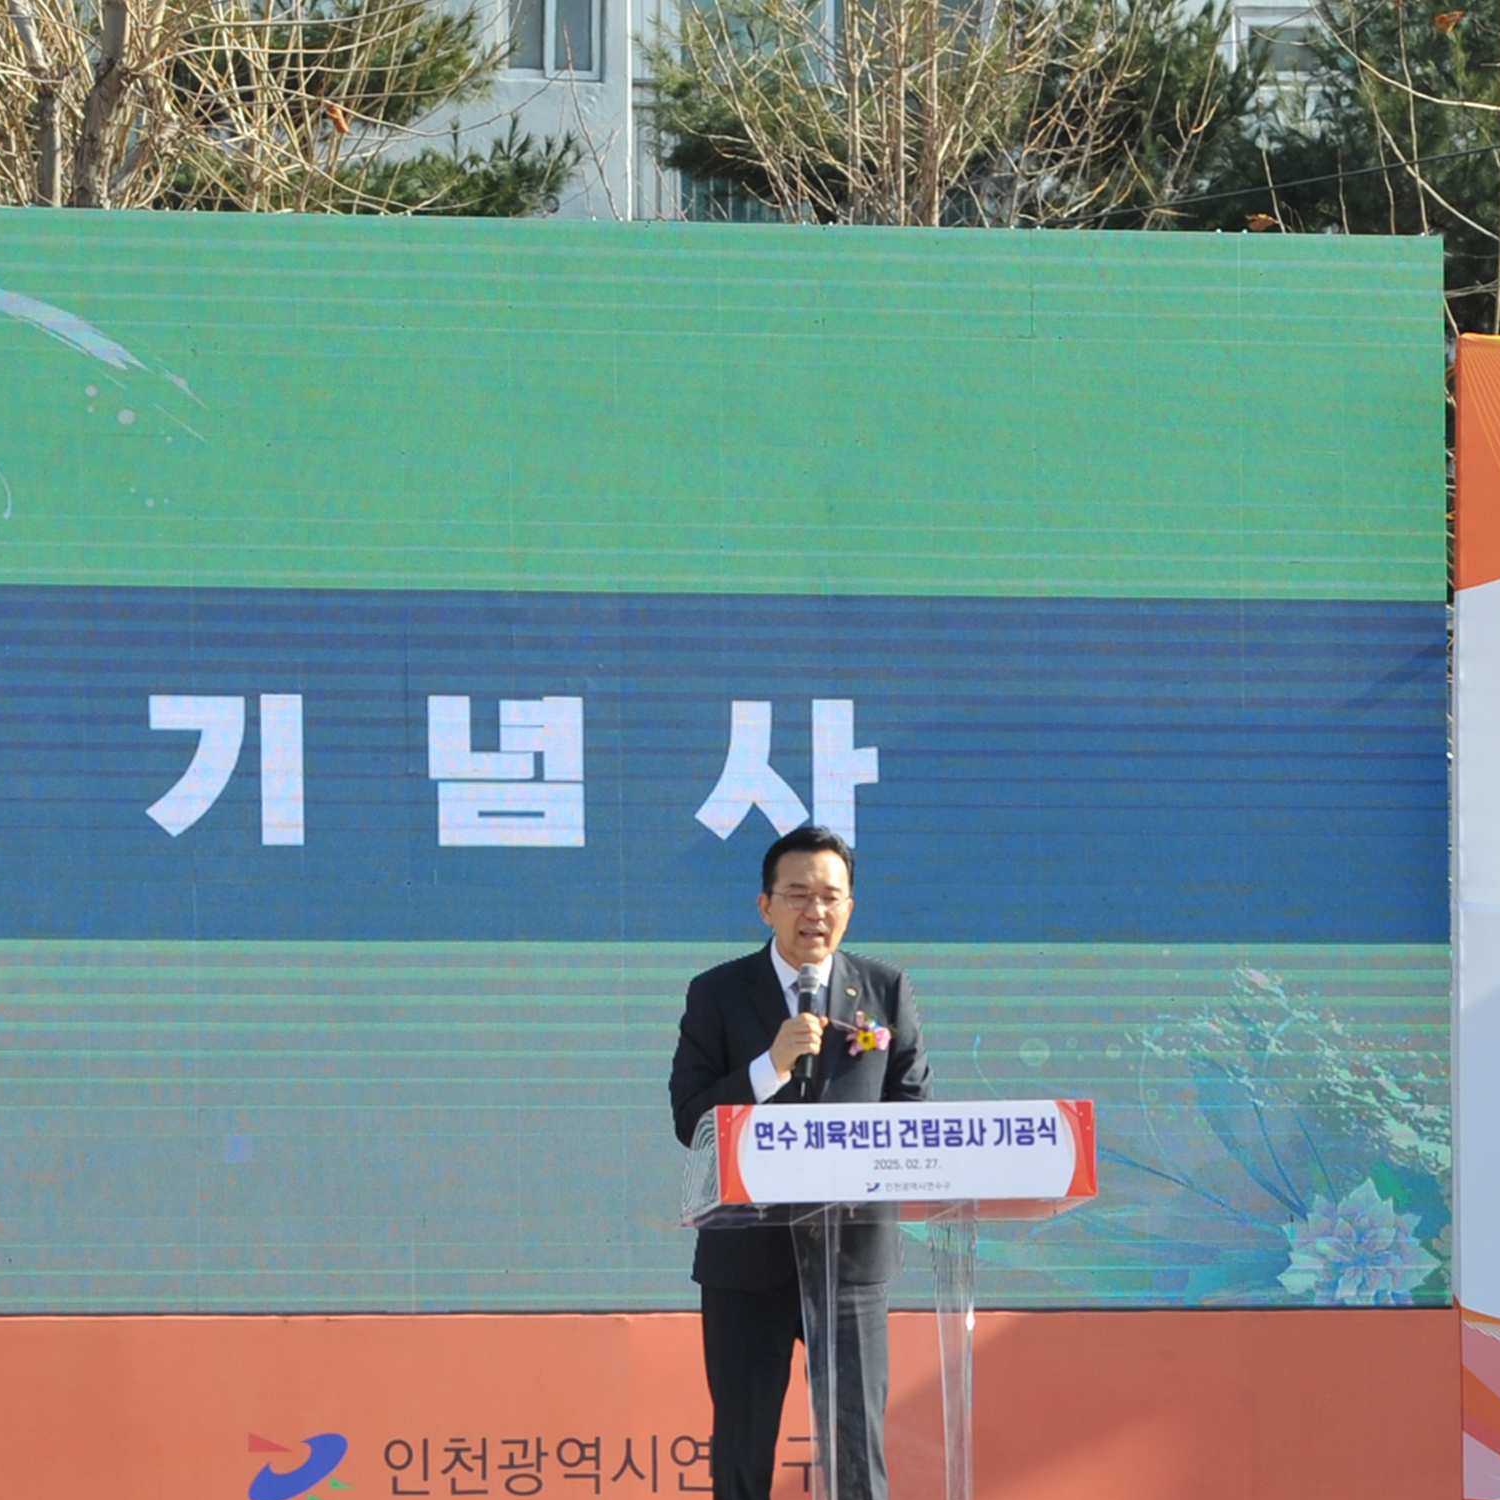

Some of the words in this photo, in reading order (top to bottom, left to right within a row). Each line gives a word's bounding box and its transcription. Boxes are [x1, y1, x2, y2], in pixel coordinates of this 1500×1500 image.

[754, 1121, 798, 1151] 연수
[804, 1119, 891, 1150] 체육센터
[898, 1117, 987, 1148] 건립공사
[992, 1116, 1057, 1146] 기공식
[873, 1159, 903, 1170] 2025.
[905, 1158, 922, 1170] 02.
[925, 1158, 942, 1169] 27.
[384, 1434, 821, 1497] 인천광역시연구
